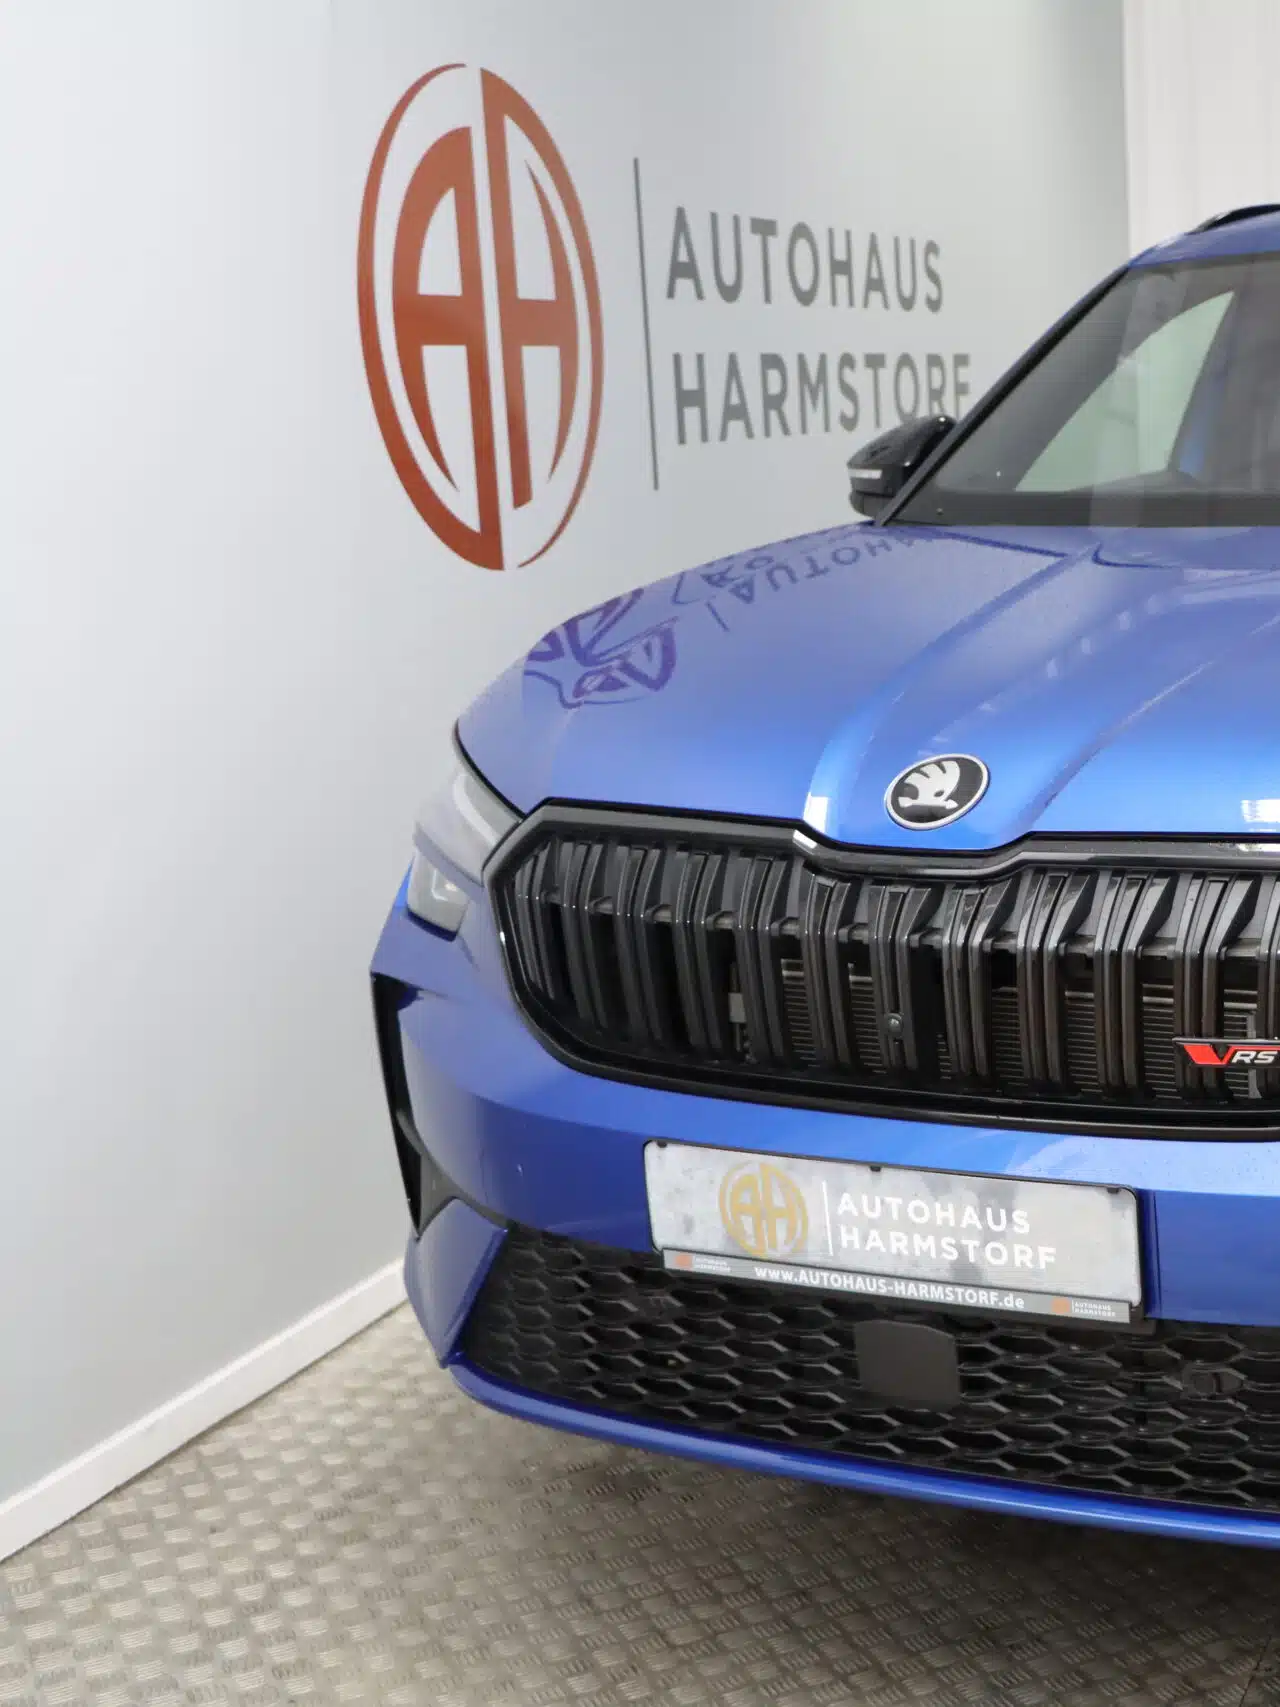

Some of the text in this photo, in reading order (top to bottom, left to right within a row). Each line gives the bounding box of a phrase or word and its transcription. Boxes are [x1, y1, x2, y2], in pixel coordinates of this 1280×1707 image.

[667, 206, 943, 313] AUTOHAUS
[672, 352, 971, 445] HARMSTORF
[837, 1192, 1030, 1234] AUTOHAUS
[840, 1223, 1056, 1270] HARMSTORF
[754, 1266, 1025, 1309] www.AUTOHAUS-HARMSTORF.de
